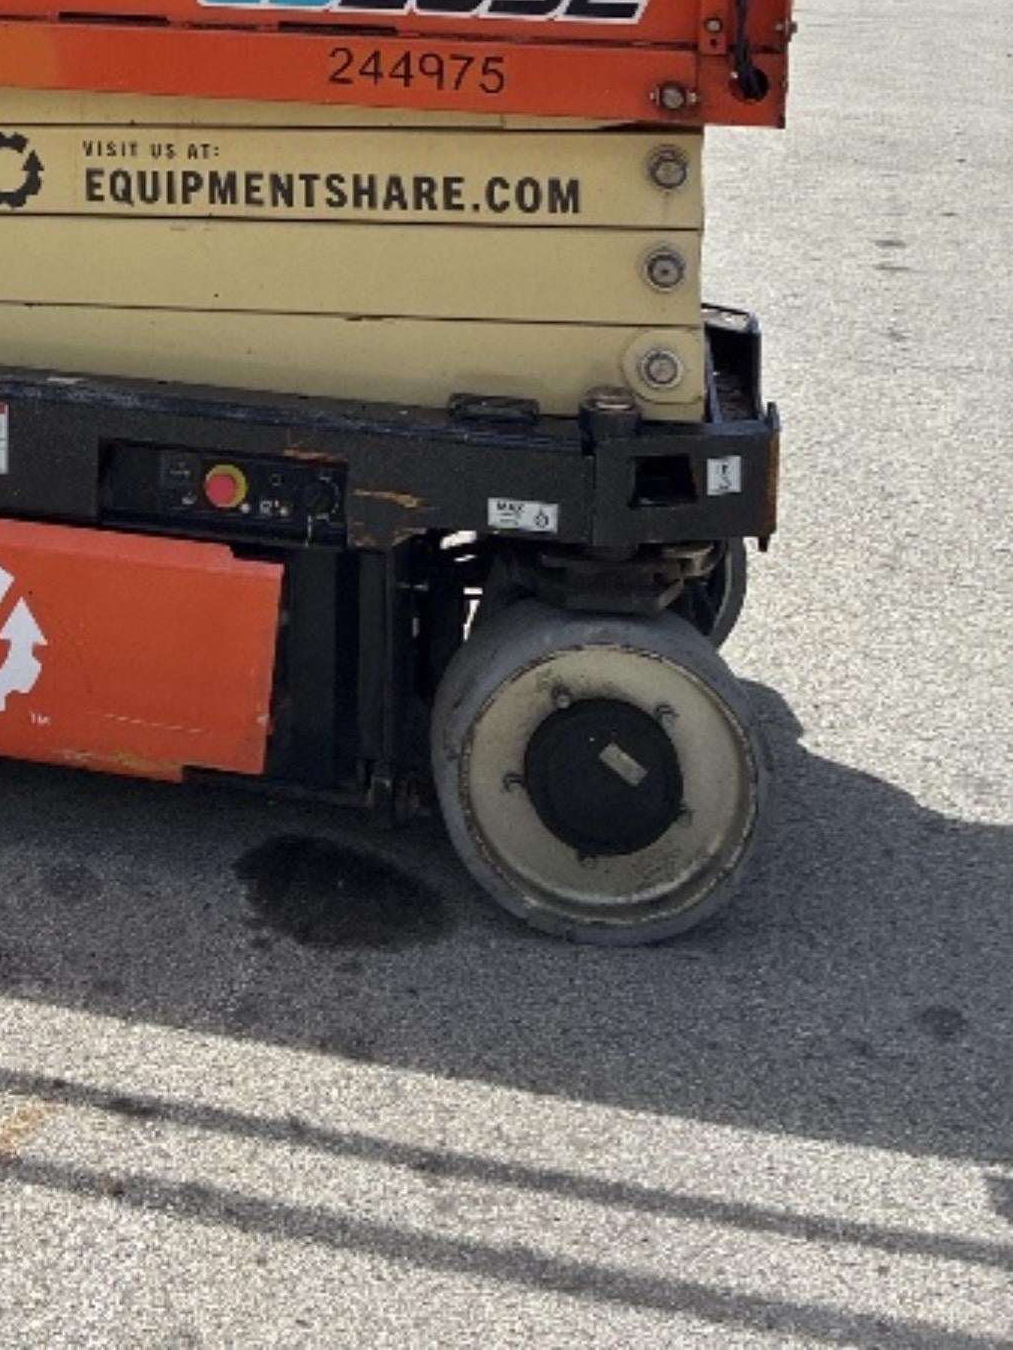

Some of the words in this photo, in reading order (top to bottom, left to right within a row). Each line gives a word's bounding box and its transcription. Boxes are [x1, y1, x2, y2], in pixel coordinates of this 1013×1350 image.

[327, 47, 506, 94] 244975
[82, 140, 138, 158] VISIT
[150, 142, 177, 160] US
[187, 142, 220, 160] AT:
[84, 167, 583, 215] EQUIPMENTSHARE.COM
